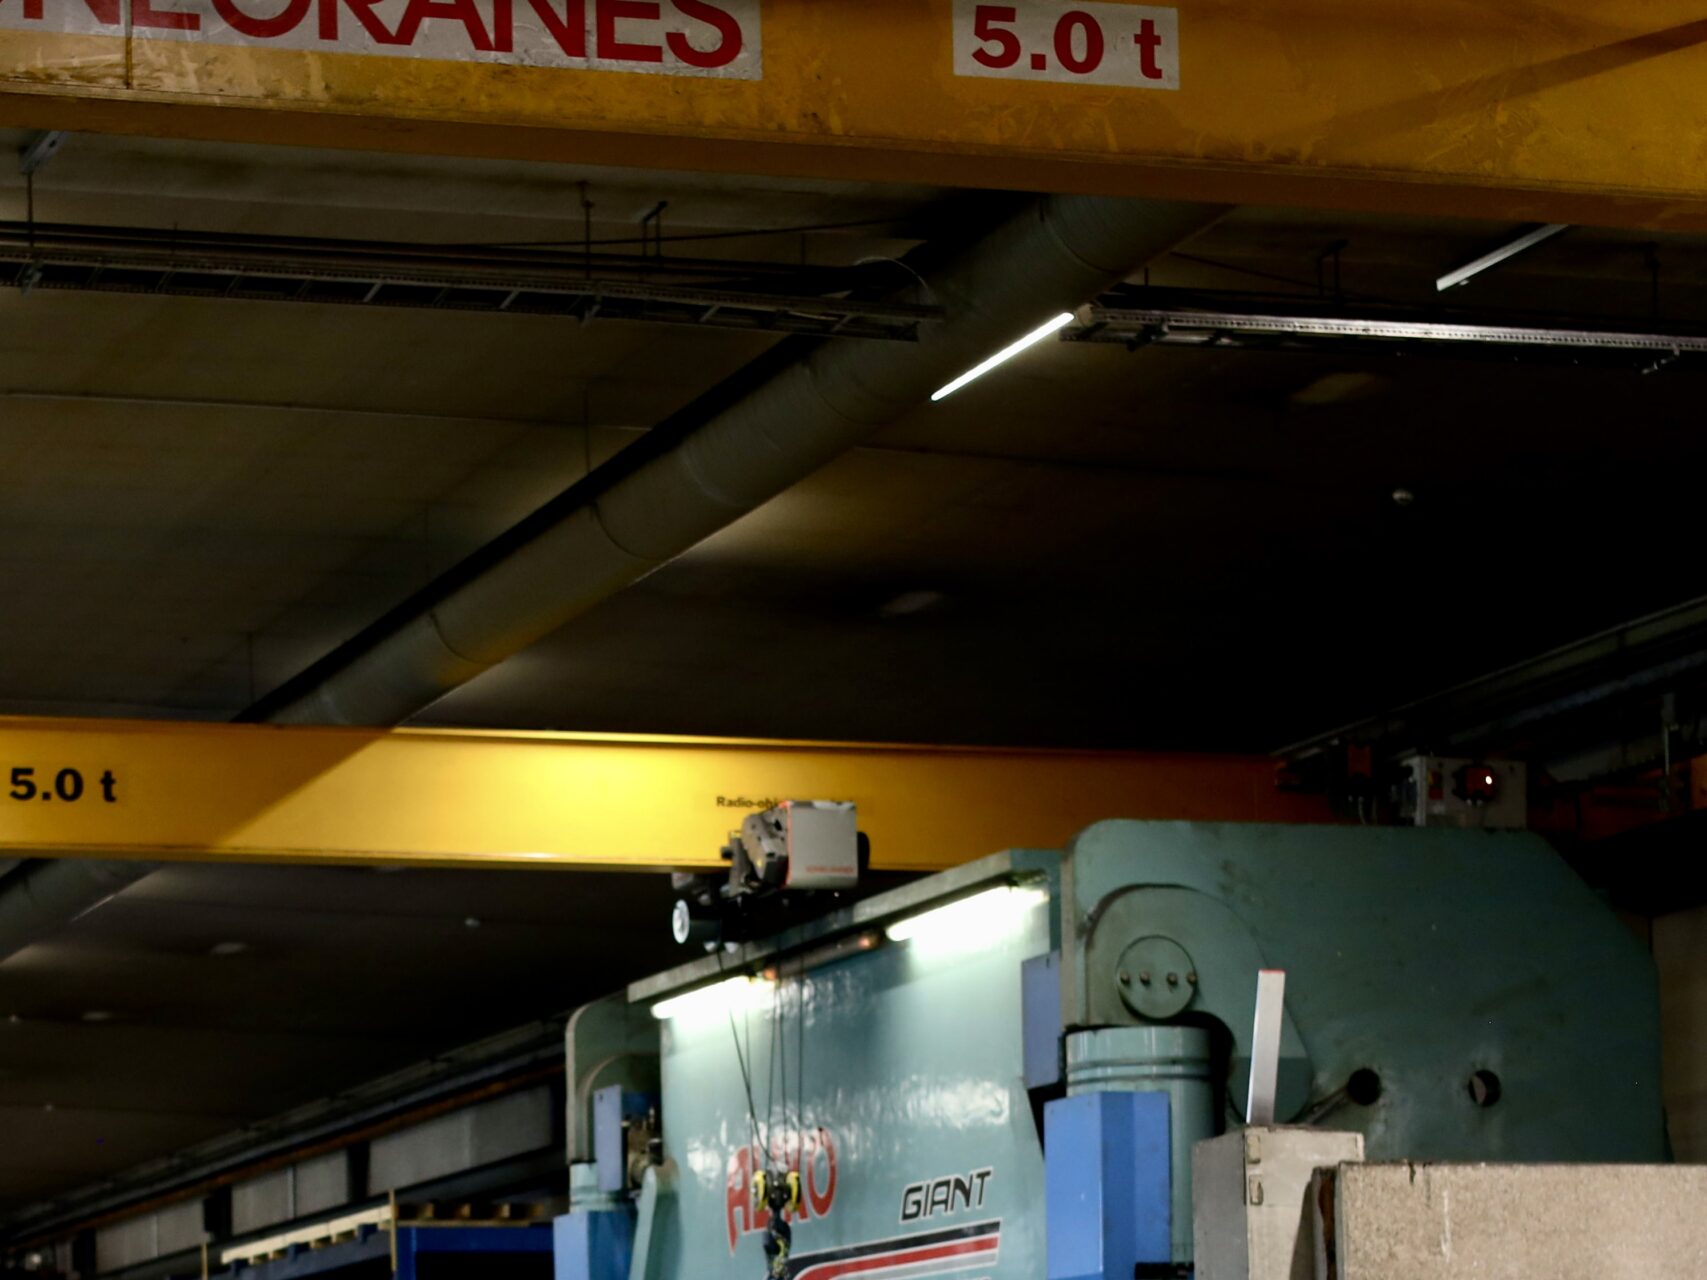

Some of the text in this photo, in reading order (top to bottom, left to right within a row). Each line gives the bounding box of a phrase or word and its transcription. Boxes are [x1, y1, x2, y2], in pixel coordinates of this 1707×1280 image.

[972, 5, 1163, 79] 5.0 t
[10, 767, 117, 802] 5.0 t
[902, 1170, 992, 1221] GIANT
